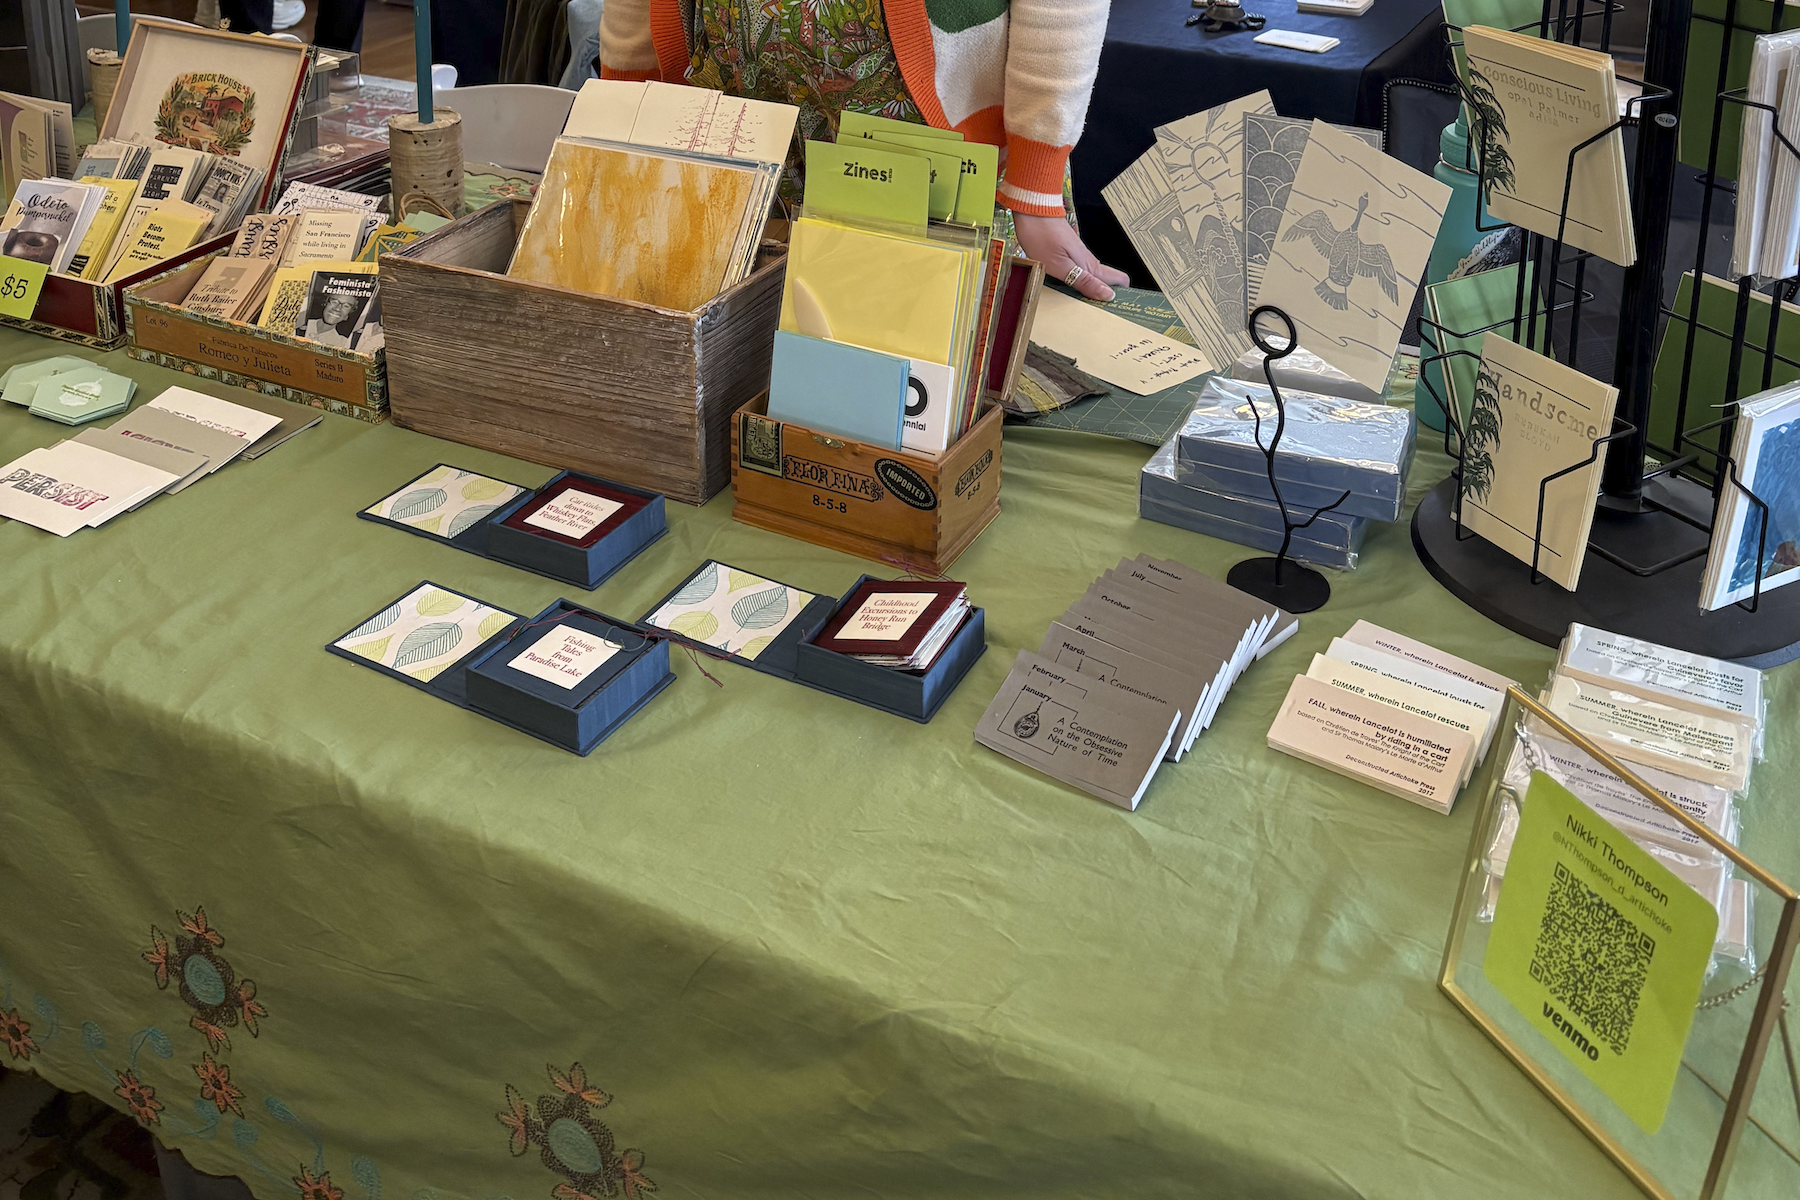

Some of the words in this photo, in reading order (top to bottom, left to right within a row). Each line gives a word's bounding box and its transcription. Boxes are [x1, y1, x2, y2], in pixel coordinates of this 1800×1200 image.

[191, 73, 217, 84] BRICK
[218, 74, 242, 93] HOUSE
[1557, 88, 1600, 118] Living
[843, 162, 893, 184] Zines!
[27, 193, 55, 209] Ode
[55, 198, 70, 210] to
[202, 200, 220, 213] Trump
[16, 206, 74, 223] Pumpernickel
[147, 223, 163, 232] Riots
[309, 220, 333, 228] Missing
[142, 231, 165, 242] Become
[306, 230, 319, 238] San
[320, 230, 351, 238] Francisco
[321, 241, 338, 250] living
[299, 251, 334, 259] Sacramento
[1, 274, 29, 300] $5
[200, 284, 230, 295] Tribute
[322, 286, 372, 298] Fashionista
[329, 277, 371, 289] Feminista
[189, 293, 210, 303] Ruth
[211, 294, 238, 305] Bader
[187, 303, 226, 315] Ginsburg
[145, 316, 157, 325] Lot
[212, 336, 238, 349] Fabrica
[238, 343, 249, 351] De
[251, 347, 278, 360] Tabacos
[199, 342, 240, 363] Romeo
[243, 357, 250, 368] y
[253, 356, 292, 378] Julieta
[314, 358, 336, 370] Series
[337, 364, 344, 373] B
[316, 369, 344, 384] Maduro
[791, 460, 829, 484] FLOR
[832, 470, 870, 495] FINA
[886, 468, 926, 500] IMPORTED
[1, 467, 110, 511] PERSIST
[564, 503, 585, 514] down
[569, 496, 583, 505] Car
[583, 500, 605, 512] Rides
[812, 494, 847, 514] 8-5-8
[539, 510, 567, 524] Feather
[567, 520, 588, 531] River
[546, 504, 578, 519] Whiskey
[576, 514, 597, 526] Flats,
[1131, 570, 1146, 581] July
[860, 606, 907, 614] Excursions
[873, 599, 919, 607] Childhood
[858, 614, 888, 622] Honey
[861, 621, 891, 631] Bridge
[1075, 624, 1095, 638] April
[560, 643, 583, 657] Tales
[563, 635, 596, 653] Fishing
[1062, 641, 1086, 656] March
[524, 651, 560, 670] Paradise
[560, 663, 582, 678] Lake
[551, 651, 573, 663] from
[1375, 640, 1402, 654] WINTER,
[1404, 651, 1434, 666] wherein
[1435, 663, 1468, 679] Lancelot
[1631, 650, 1665, 663] wherein
[1667, 660, 1704, 673] Lancelot
[1705, 669, 1730, 680] jousts
[1032, 664, 1067, 684] February
[1098, 674, 1105, 682] A
[1667, 665, 1719, 682] Guinevere's
[1720, 679, 1744, 688] favor
[1021, 684, 1053, 702] January
[1331, 678, 1366, 696] SUMMER,
[1368, 691, 1400, 707] wherein
[1401, 702, 1437, 719] Lancelot
[1437, 715, 1470, 731] rescues
[1308, 698, 1327, 711] FALL,
[1330, 706, 1361, 722] wherein
[1362, 717, 1398, 735] Lancelot
[1406, 733, 1451, 754] humiliated
[1580, 694, 1618, 711] SUMMER,
[1621, 707, 1656, 721] wherein
[1658, 718, 1697, 732] Lancelot
[1699, 729, 1734, 742] rescues
[1057, 717, 1065, 726] A
[1069, 721, 1128, 750] Contemplation
[1612, 711, 1658, 728] Guinevere
[1660, 724, 1681, 734] from
[1683, 731, 1733, 747] Maleagant
[1052, 726, 1064, 735] on
[1066, 731, 1080, 742] the
[1083, 737, 1123, 758] Obsessive
[1297, 709, 1316, 722] based
[1316, 717, 1325, 725] on
[1350, 729, 1360, 738] de
[1381, 740, 1392, 749] The
[1392, 746, 1411, 756] Knight
[1420, 754, 1430, 763] the
[1431, 758, 1446, 768] Cart
[1322, 726, 1334, 734] and
[1342, 733, 1365, 746] Thomas
[1365, 742, 1390, 756] Malory's
[1398, 754, 1417, 765] Morte
[1375, 731, 1387, 740] by
[1388, 736, 1411, 750] riding
[1413, 744, 1421, 753] in
[1430, 752, 1448, 762] cart
[1047, 733, 1078, 751] Nature
[1082, 749, 1093, 757] of
[1097, 752, 1118, 767] Time
[1345, 754, 1389, 774] Deconstructed
[1389, 770, 1419, 785] Artichoke
[1419, 781, 1436, 791] Press
[1550, 754, 1583, 771] WINTER,
[1586, 767, 1623, 783] wherein
[1418, 788, 1433, 796] 2017
[1676, 801, 1706, 816] sanity
[1679, 795, 1708, 808] struck
[1565, 813, 1599, 852] Nikki
[1600, 841, 1669, 907] Thompson
[1552, 830, 1674, 935] @NThompson_d_artichoke
[1542, 1001, 1599, 1062] venmo
